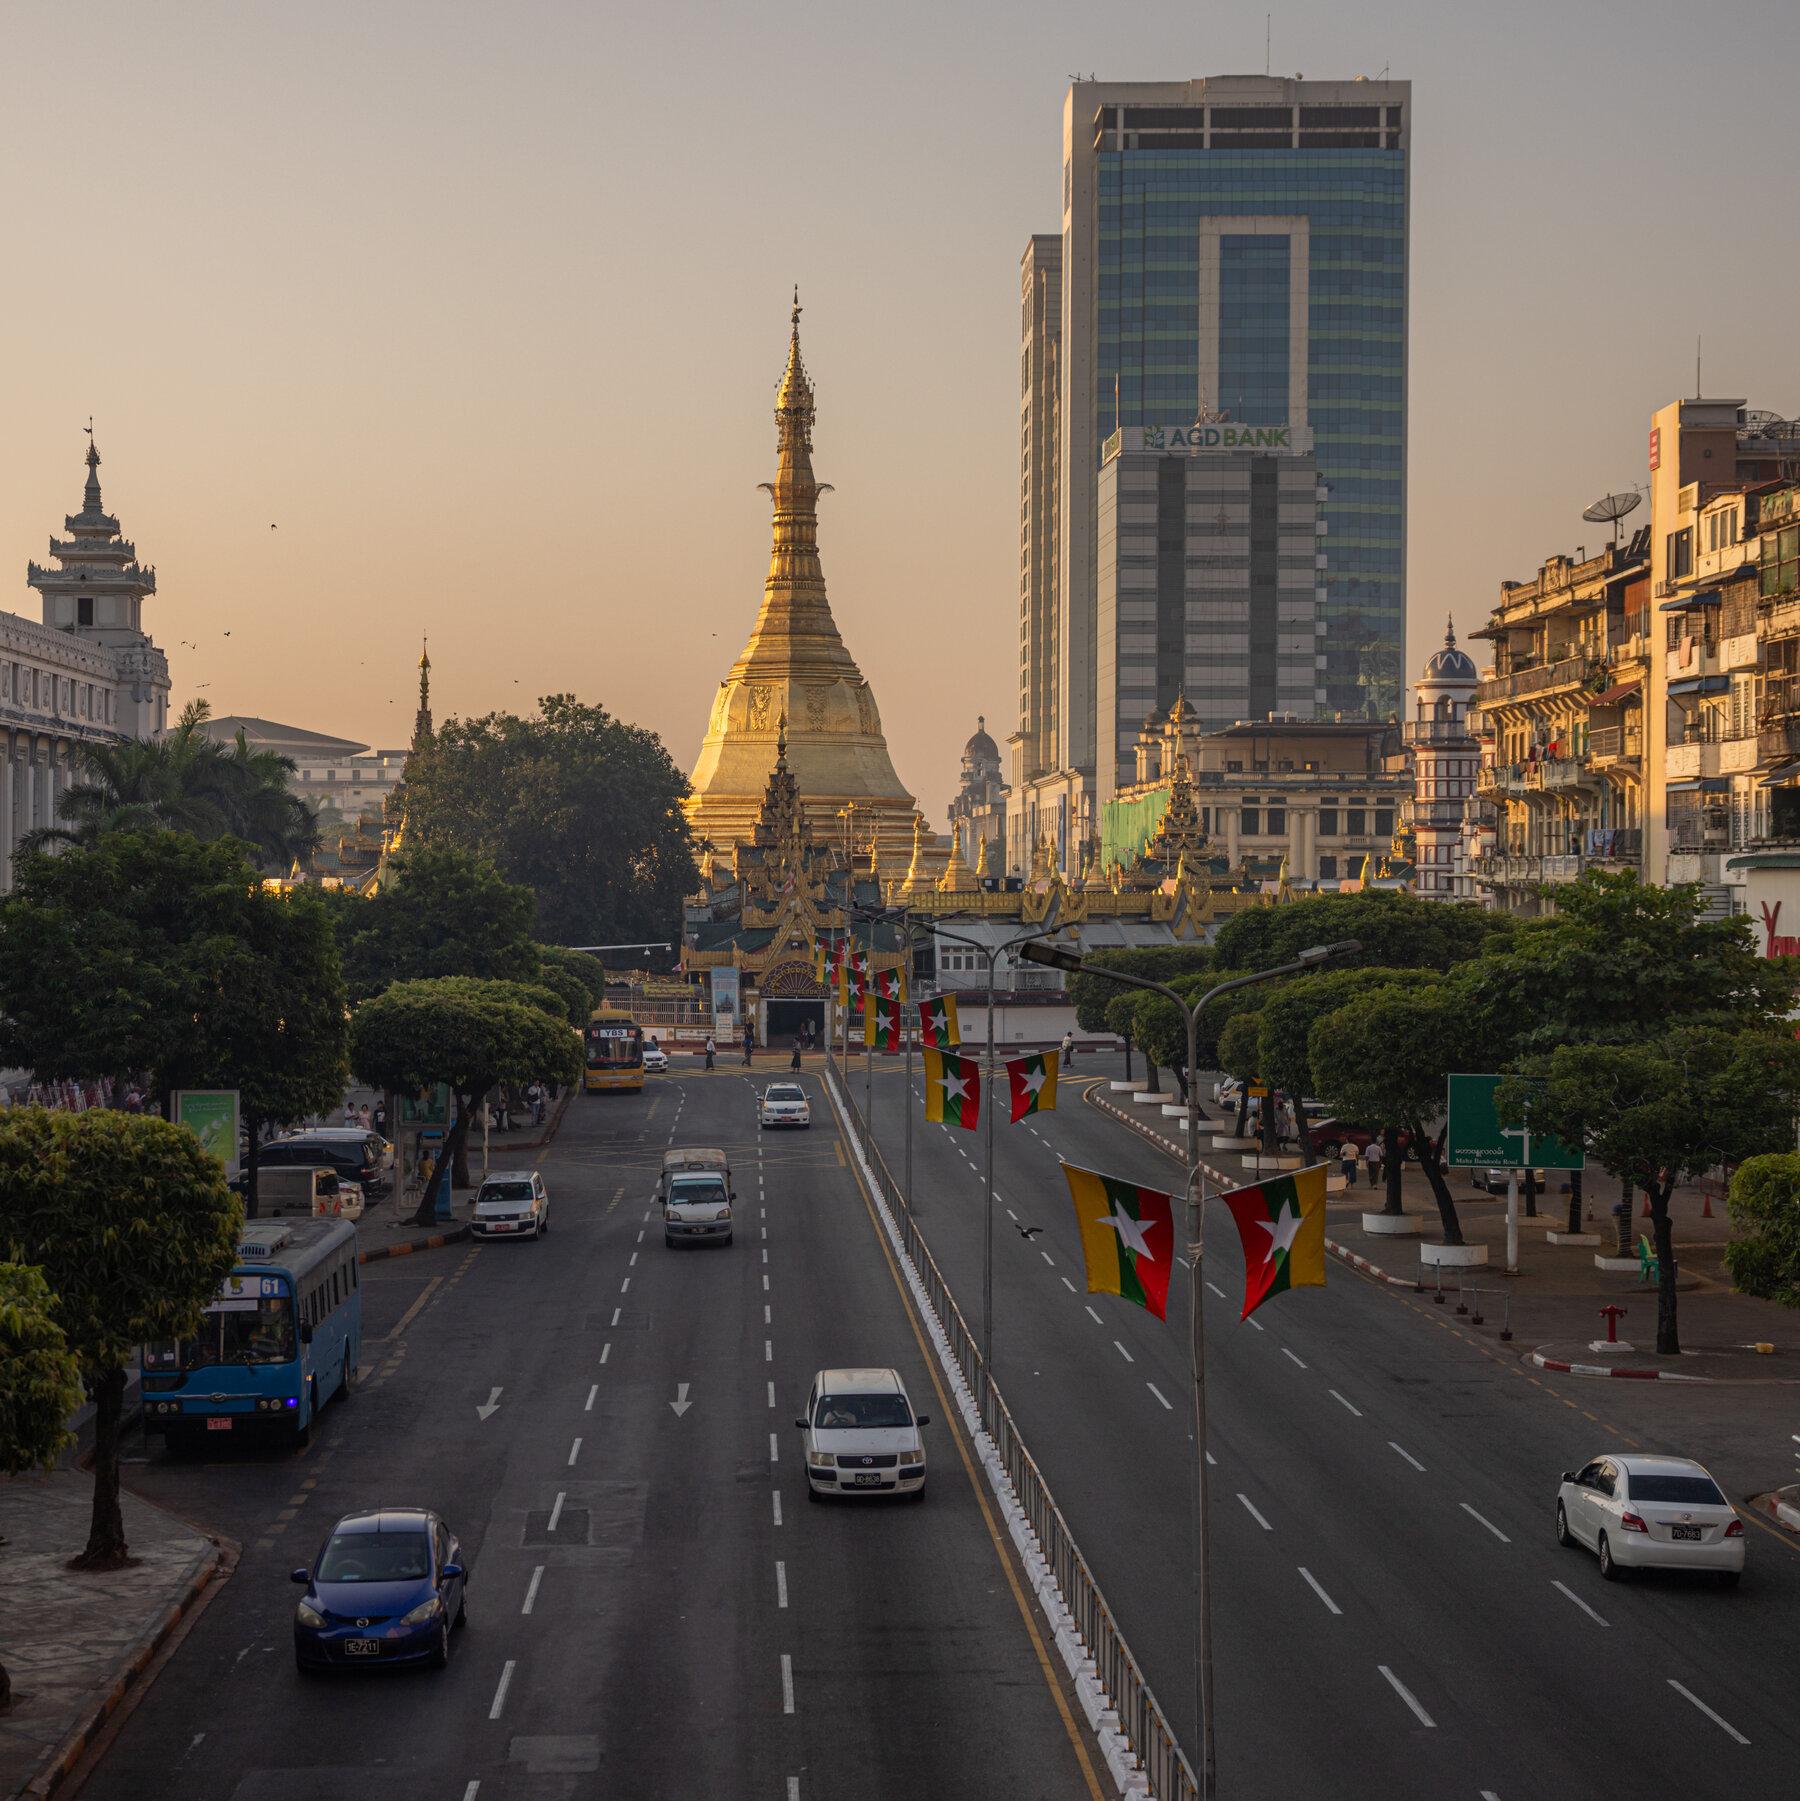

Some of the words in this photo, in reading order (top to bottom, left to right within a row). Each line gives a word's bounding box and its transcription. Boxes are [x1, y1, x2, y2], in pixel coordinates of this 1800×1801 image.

[1169, 428, 1220, 447] AGD
[1223, 428, 1290, 447] BANK
[605, 1029, 624, 1037] YBS
[1455, 1157, 1473, 1165] Maha
[262, 1279, 280, 1295] 61
